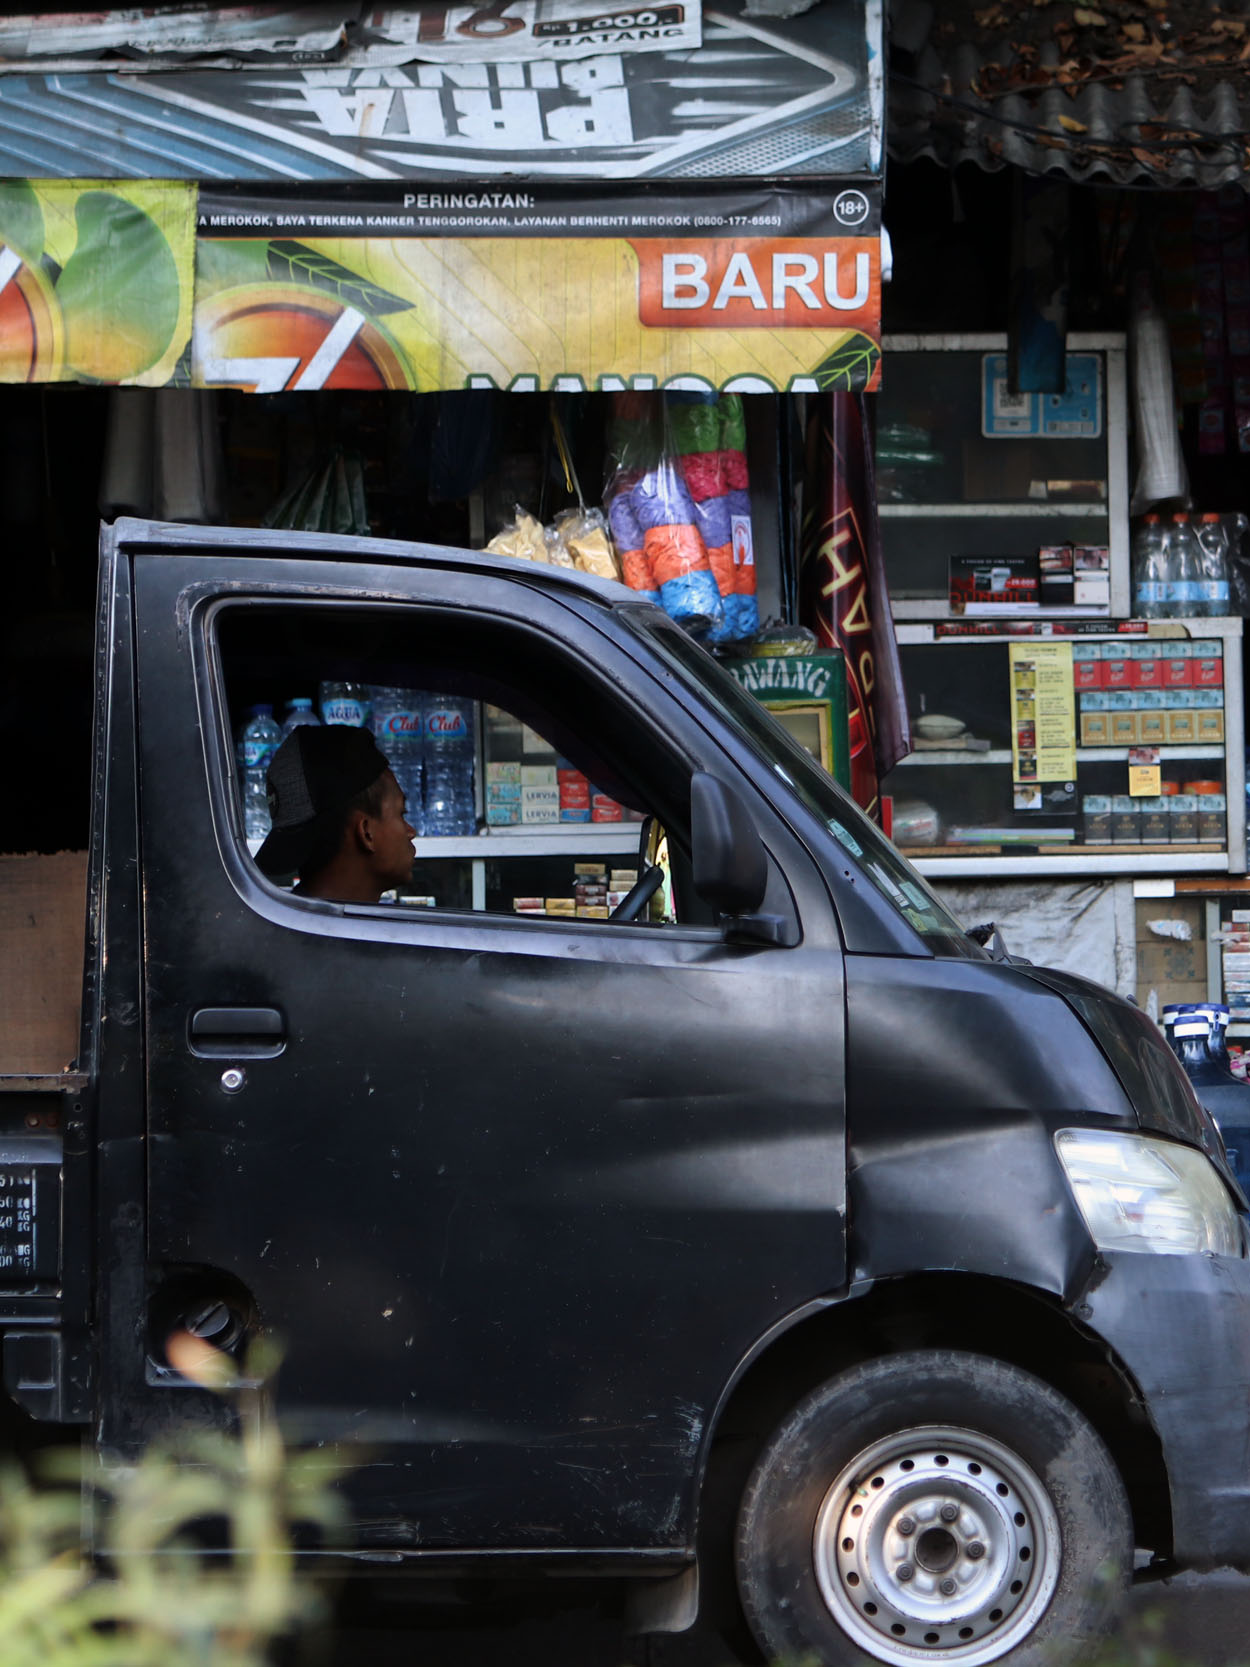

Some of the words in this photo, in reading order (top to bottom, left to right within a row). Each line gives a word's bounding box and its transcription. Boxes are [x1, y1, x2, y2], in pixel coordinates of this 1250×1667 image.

[305, 87, 634, 142] PRIA
[403, 194, 535, 209] PERINGATAN:
[838, 201, 866, 215] 18+
[210, 216, 273, 227] MEROKOK,
[276, 216, 306, 226] SAYA
[309, 216, 363, 226] TERKENA
[366, 216, 414, 226] KANKER
[417, 216, 511, 227] TENGGOROKAN.
[514, 216, 567, 226] LAYANAN
[570, 216, 629, 226] BERHENTI
[631, 216, 691, 226] MEROKOK
[661, 252, 870, 311] BARU
[936, 624, 999, 635] DUNHILL
[327, 706, 361, 721] AQUA
[429, 716, 460, 732] Club
[526, 790, 557, 800] LERVIA
[526, 810, 557, 819] LERVIA
